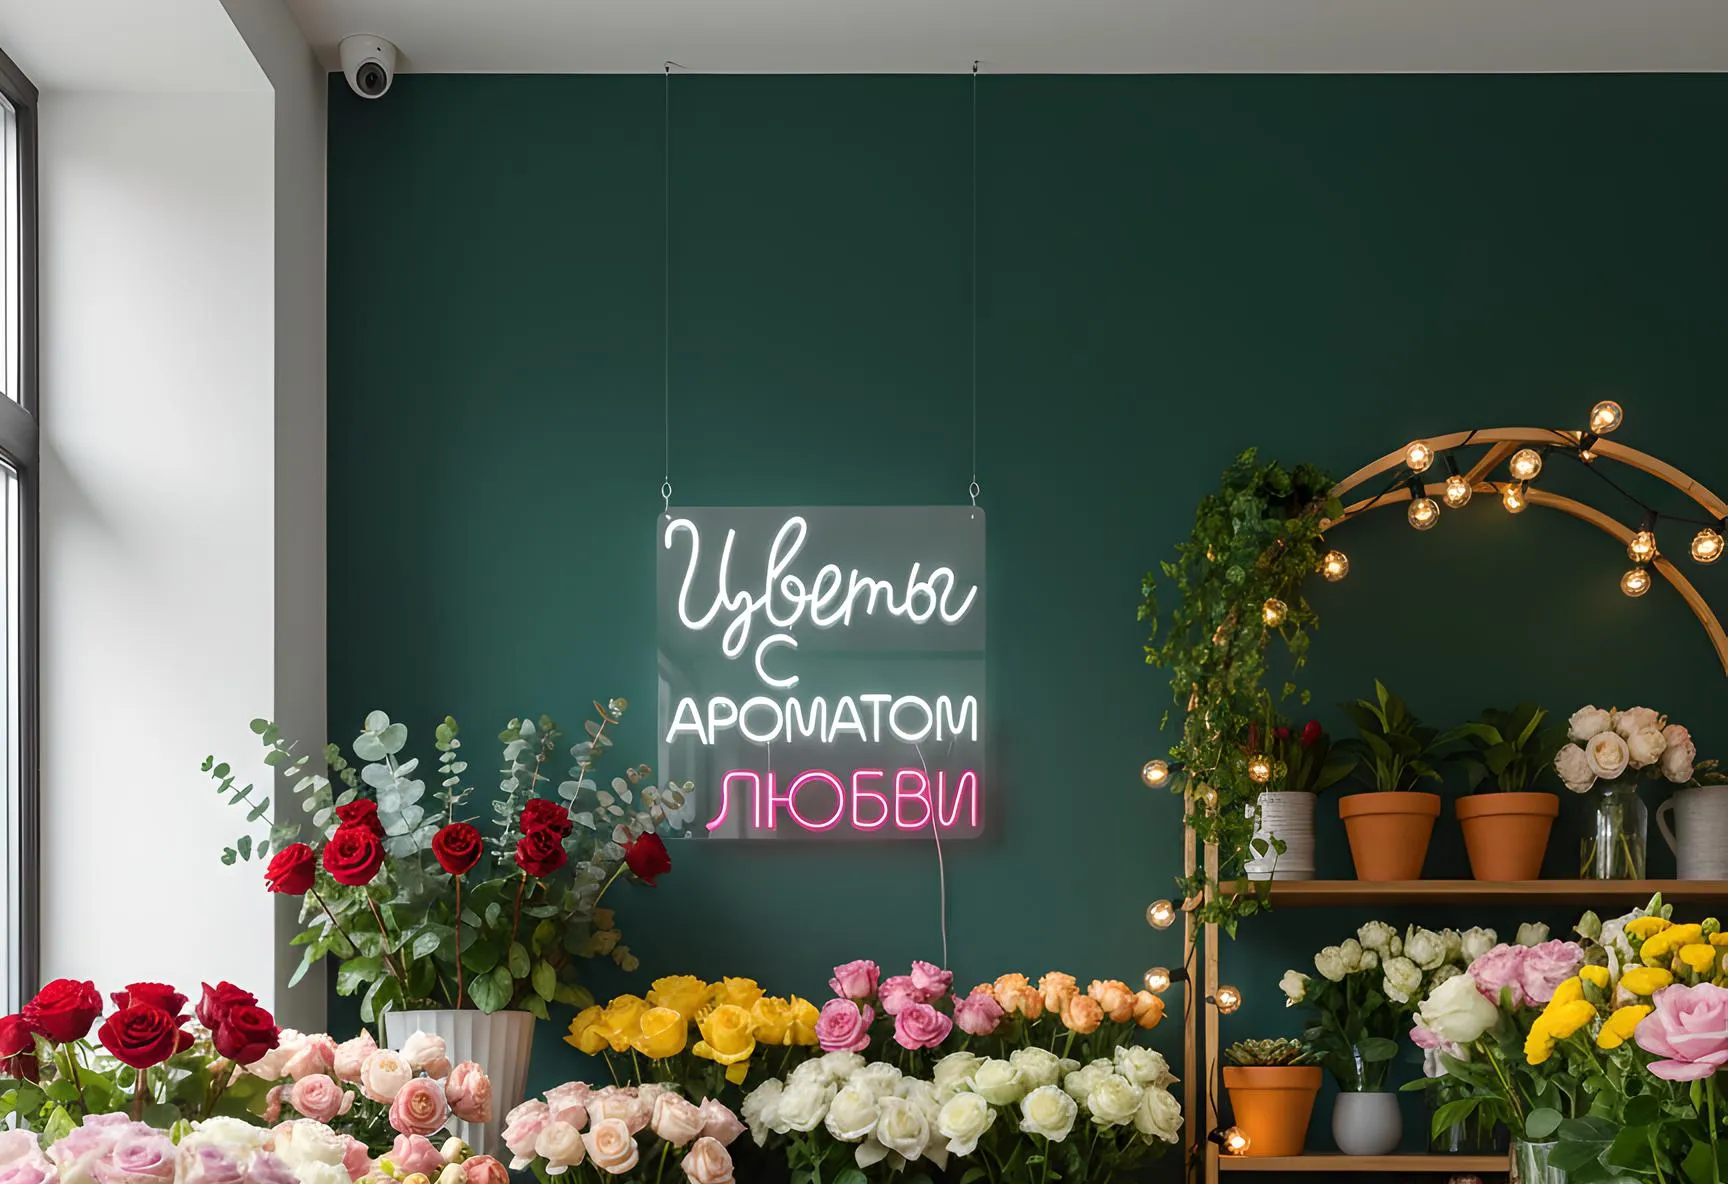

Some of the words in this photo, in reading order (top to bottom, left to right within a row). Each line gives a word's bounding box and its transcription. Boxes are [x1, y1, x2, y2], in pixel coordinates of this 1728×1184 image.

[664, 516, 978, 659] Цветы
[665, 694, 978, 745] АРОМАТОМ
[705, 769, 978, 831] ЛЮБВИ
